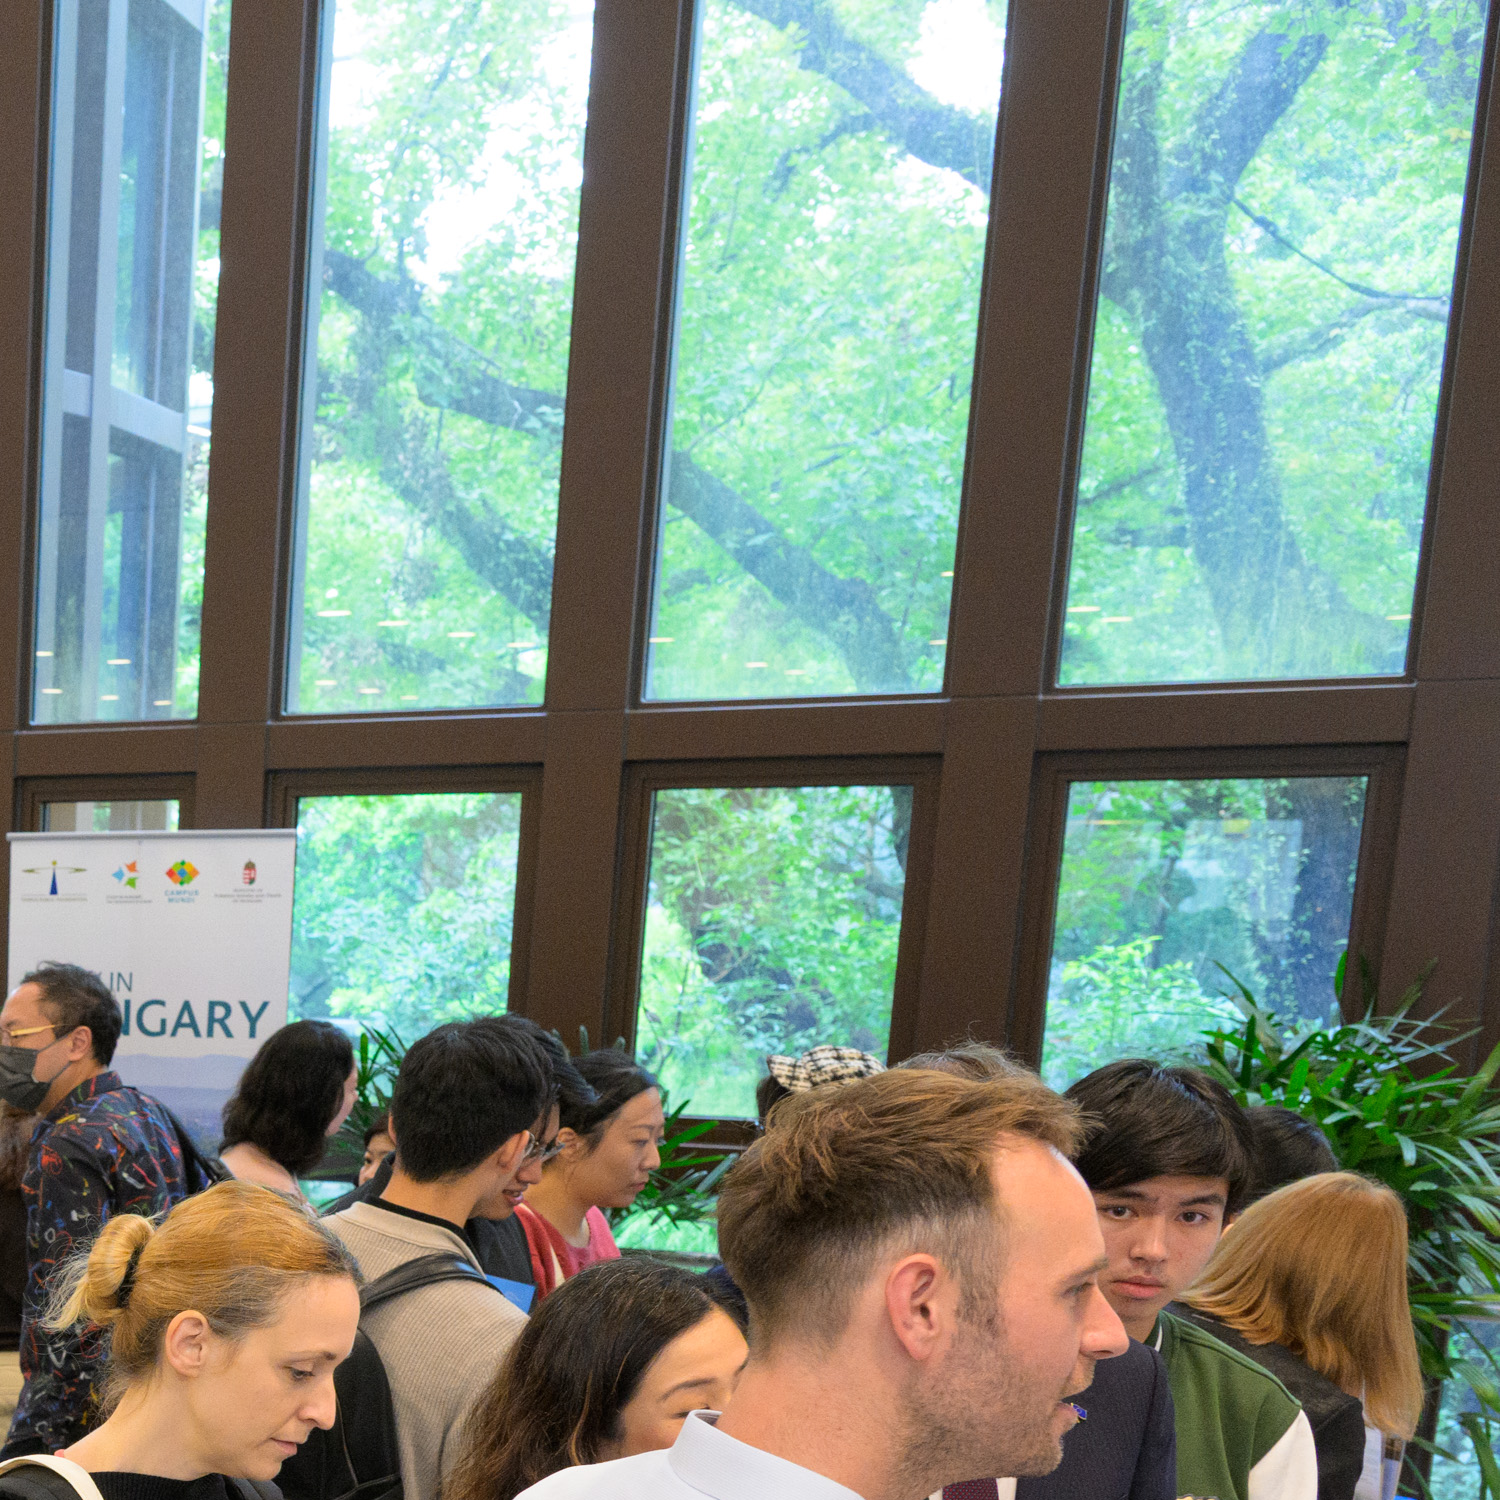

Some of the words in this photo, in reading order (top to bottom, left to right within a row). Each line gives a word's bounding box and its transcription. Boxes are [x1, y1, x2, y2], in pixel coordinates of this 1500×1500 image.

[164, 889, 200, 897] CAMPUS
[109, 971, 133, 993] IN
[119, 999, 270, 1039] GARY
